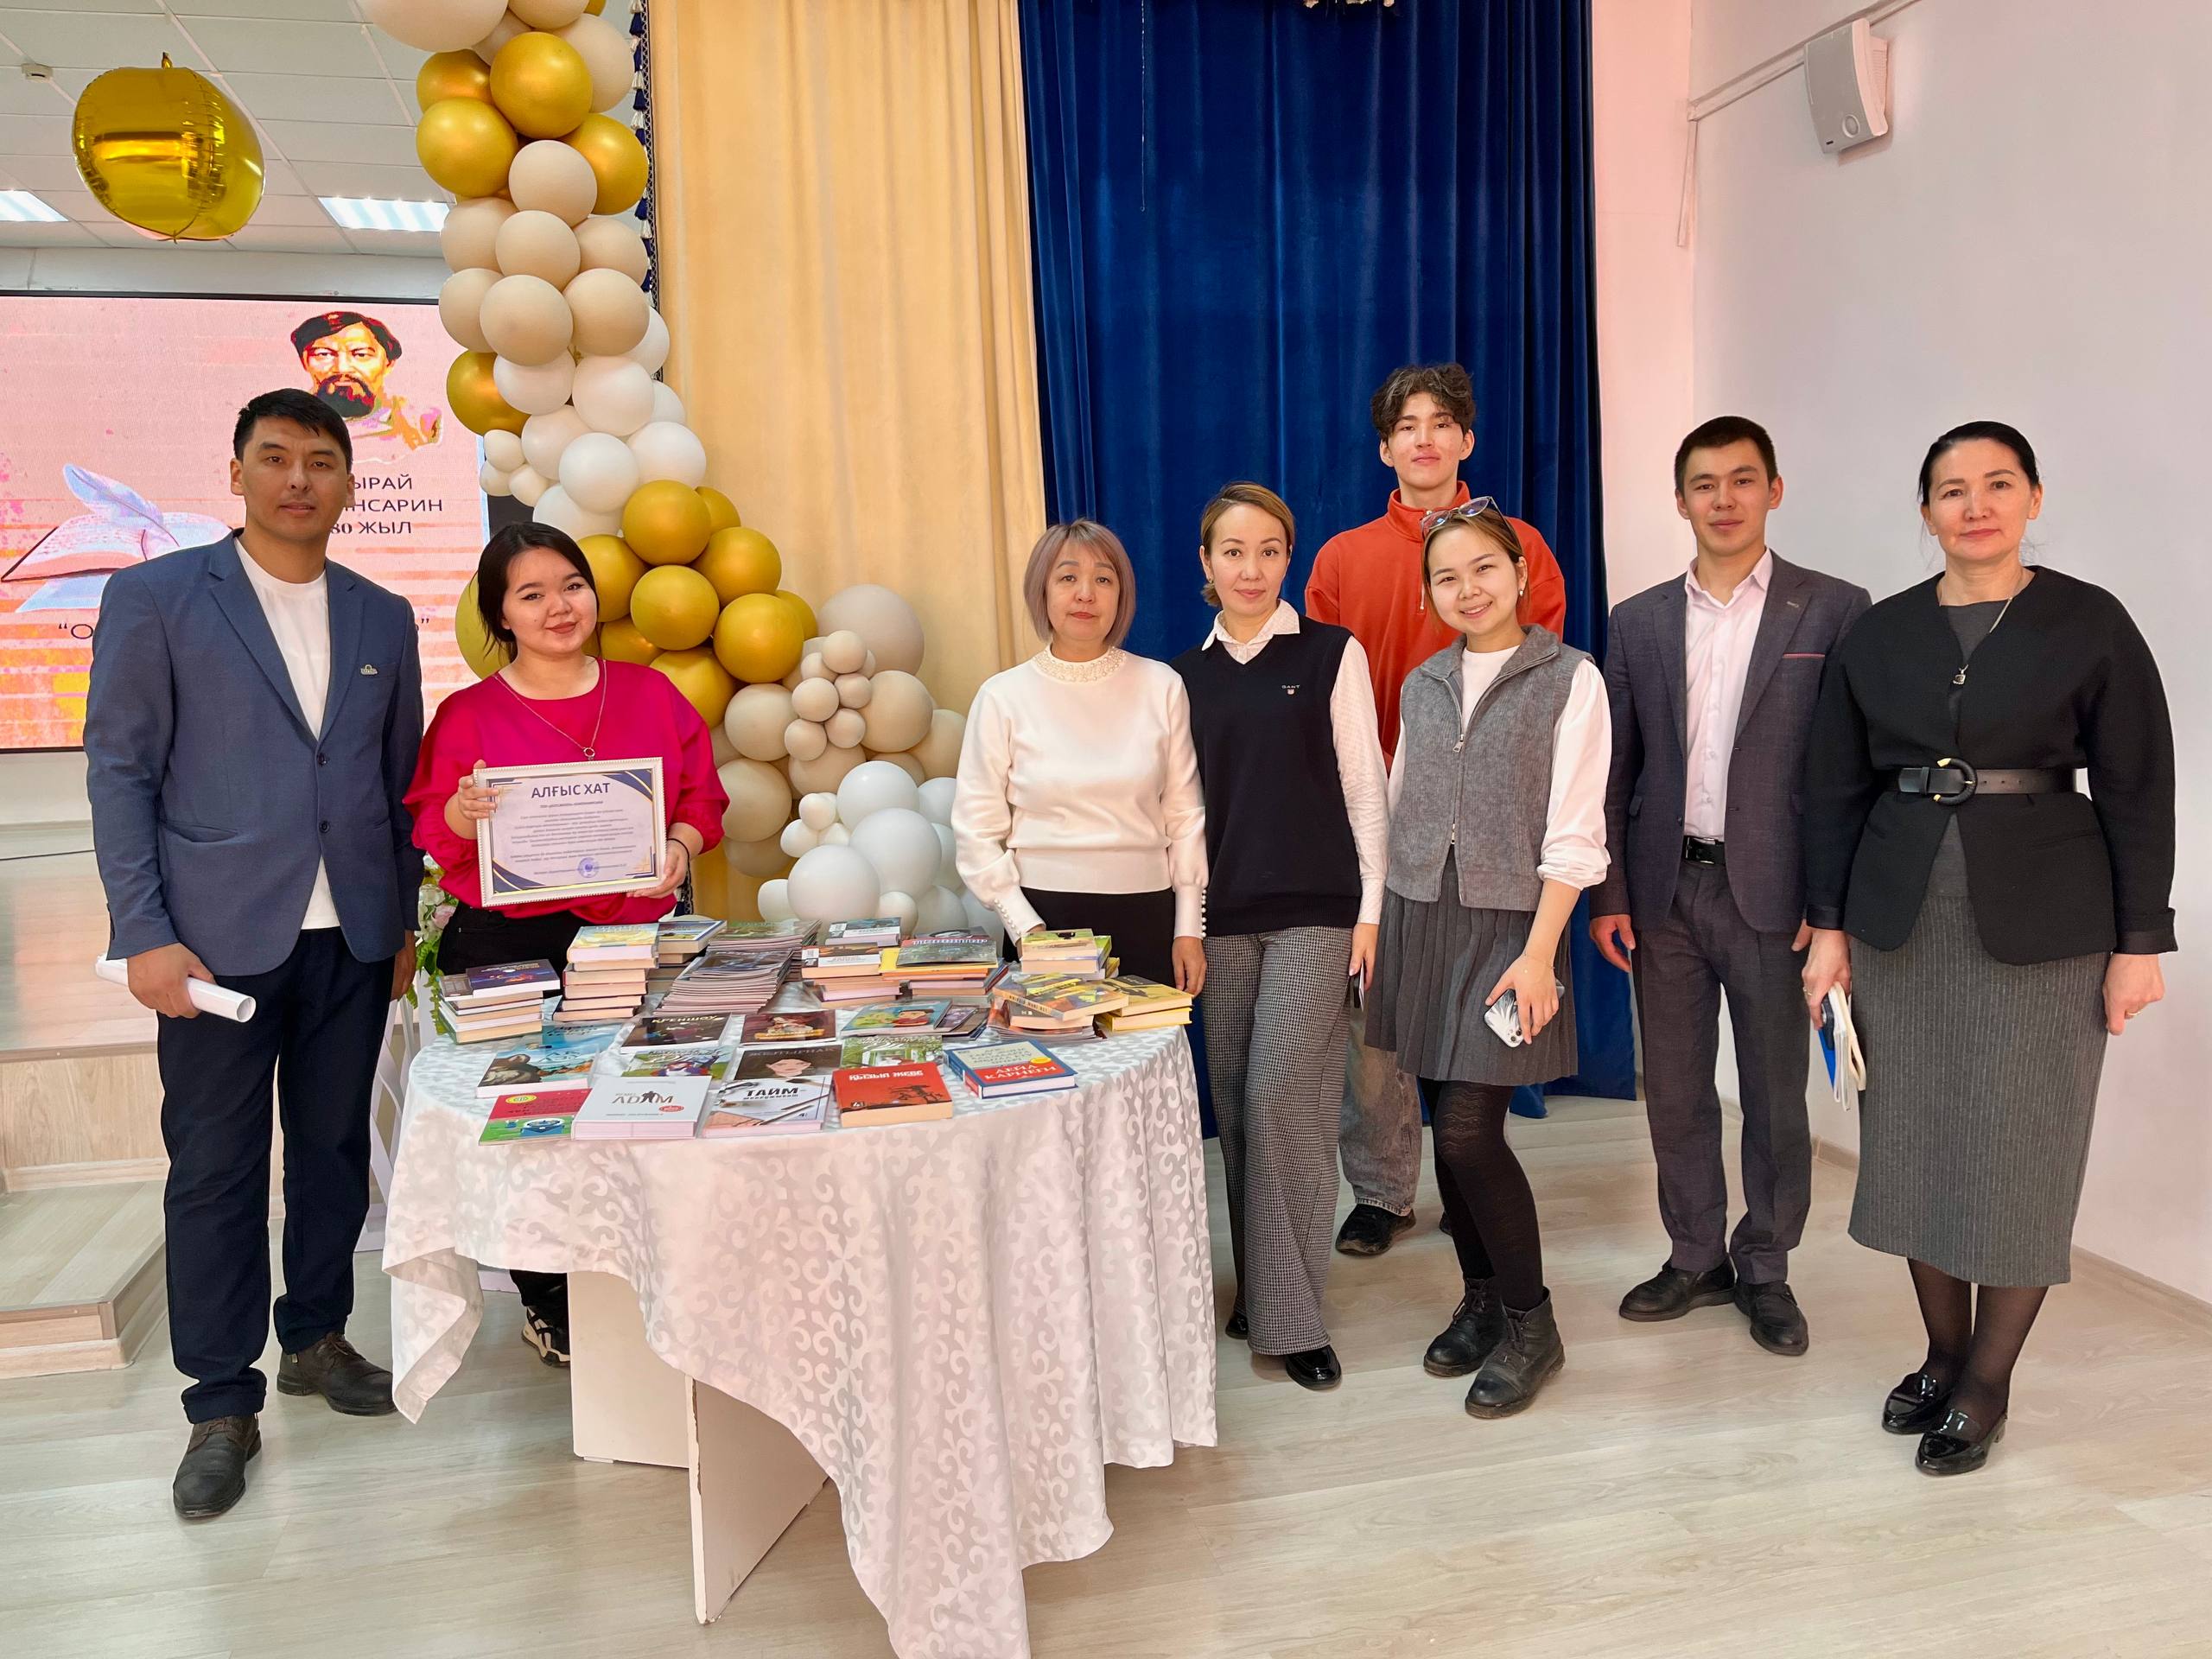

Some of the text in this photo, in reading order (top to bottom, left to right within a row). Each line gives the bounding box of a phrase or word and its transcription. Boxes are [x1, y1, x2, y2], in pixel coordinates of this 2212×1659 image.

[345, 499, 443, 512] НСАРИН
[359, 521, 411, 534] ЖЫЛ
[531, 782, 611, 798] АЛҒЫС ХАТ
